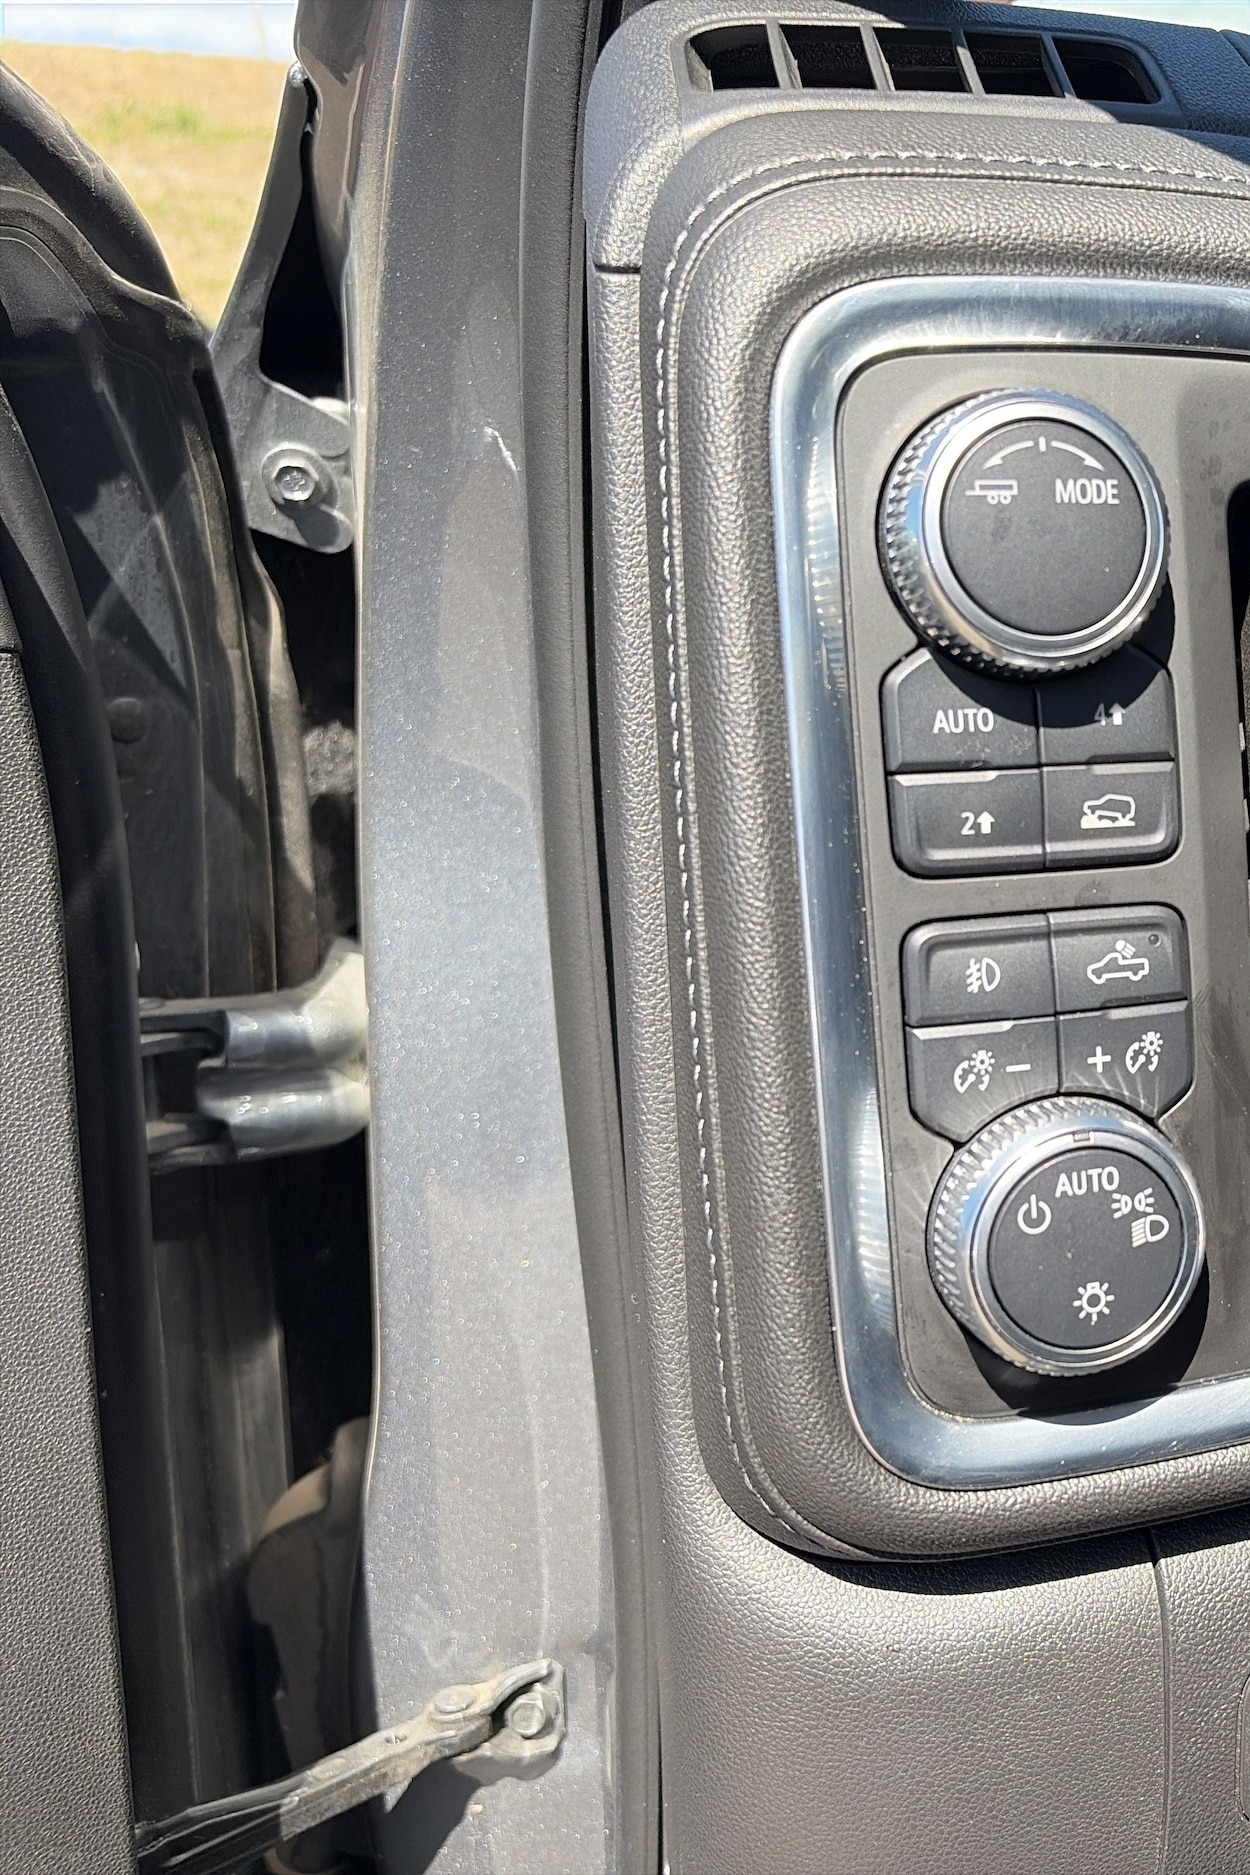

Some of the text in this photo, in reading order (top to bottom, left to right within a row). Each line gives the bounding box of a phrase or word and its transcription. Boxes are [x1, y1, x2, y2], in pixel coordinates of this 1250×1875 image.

[1054, 478, 1121, 506] MODE
[932, 707, 995, 734] AUTO
[1094, 703, 1107, 727] 4
[960, 811, 976, 836] 2
[1054, 1166, 1120, 1197] AUTO
